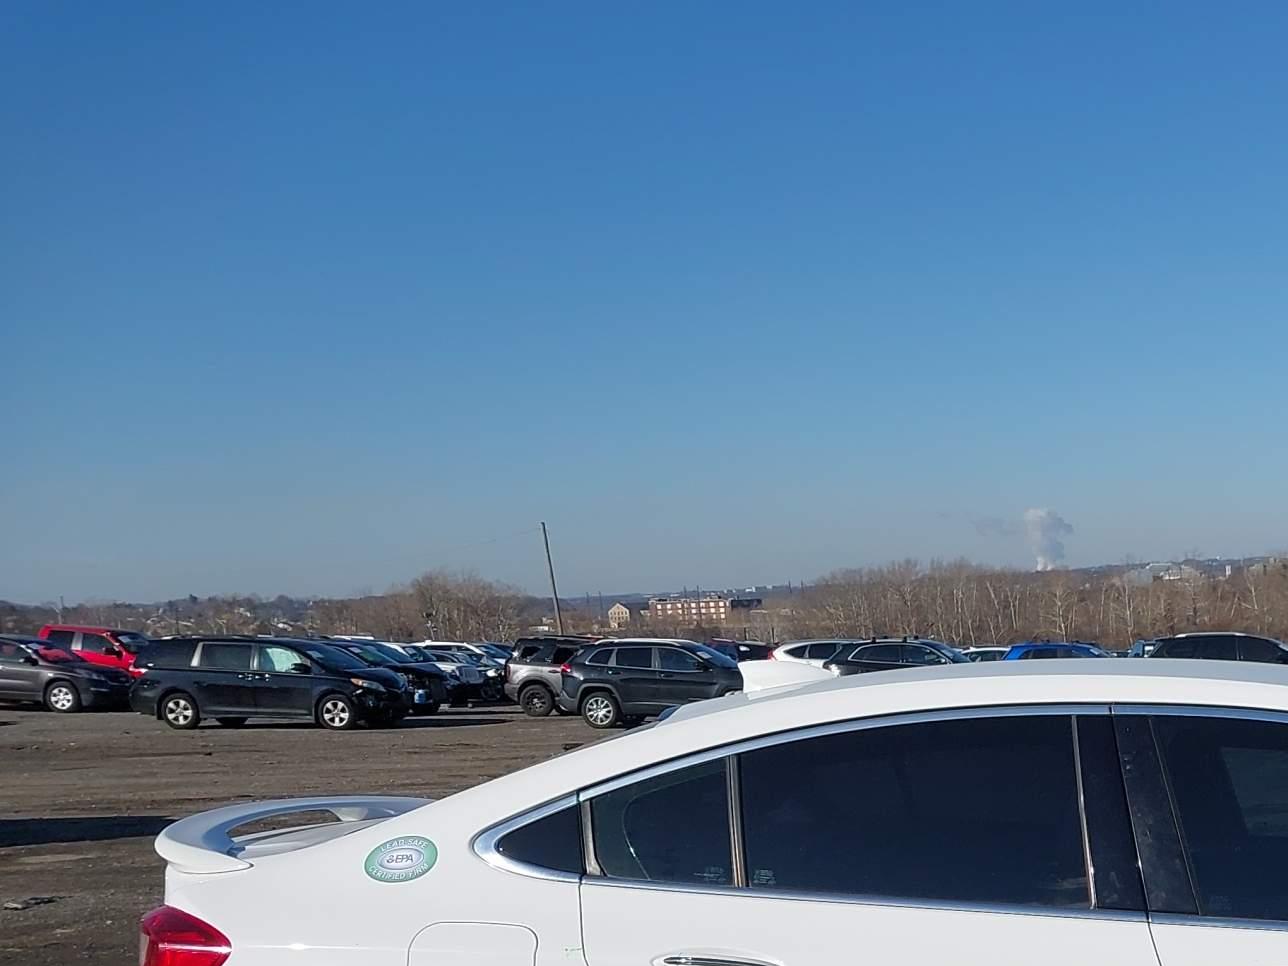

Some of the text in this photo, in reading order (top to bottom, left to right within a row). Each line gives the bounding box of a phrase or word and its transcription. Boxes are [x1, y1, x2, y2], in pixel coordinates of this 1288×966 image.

[380, 838, 429, 852] LEAD SAFE
[395, 854, 414, 864] EPA
[369, 863, 430, 880] CERTIFIED FIRM
